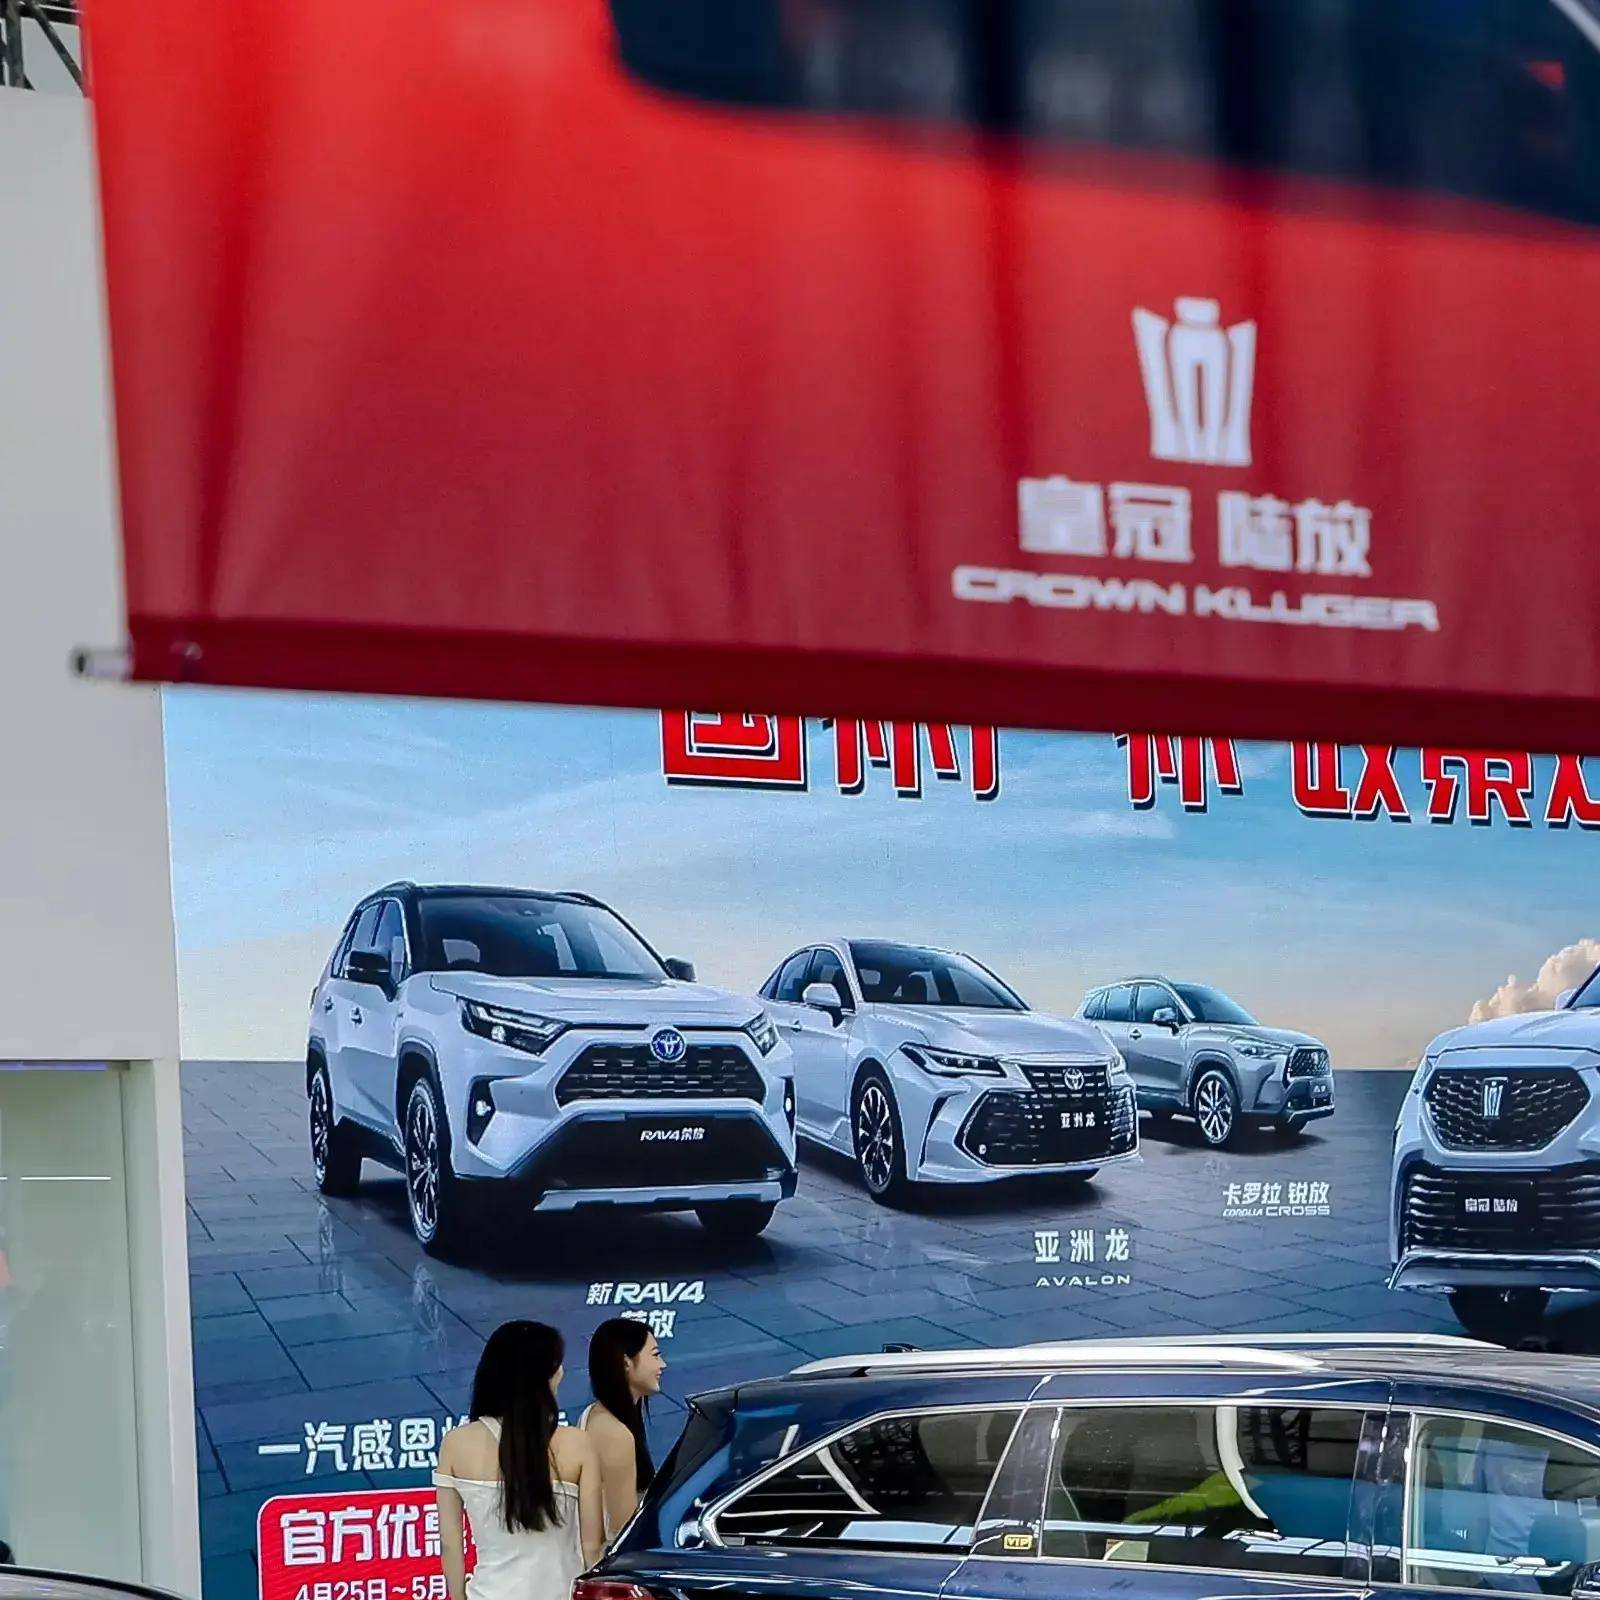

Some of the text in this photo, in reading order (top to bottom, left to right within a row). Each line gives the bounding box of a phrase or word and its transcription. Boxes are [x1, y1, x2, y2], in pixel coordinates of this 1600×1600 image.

[1017, 475, 1371, 577] 皇冠 陆放
[951, 565, 1439, 631] CROWN KLUGER
[1222, 1181, 1330, 1206] 卡罗拉 锐放
[1265, 1205, 1330, 1217] CROSS
[1034, 1228, 1130, 1264] 亚洲龙
[586, 1280, 706, 1305] 新RAV4
[1035, 1274, 1131, 1288] AVALON
[1007, 1537, 1030, 1547] VIP
